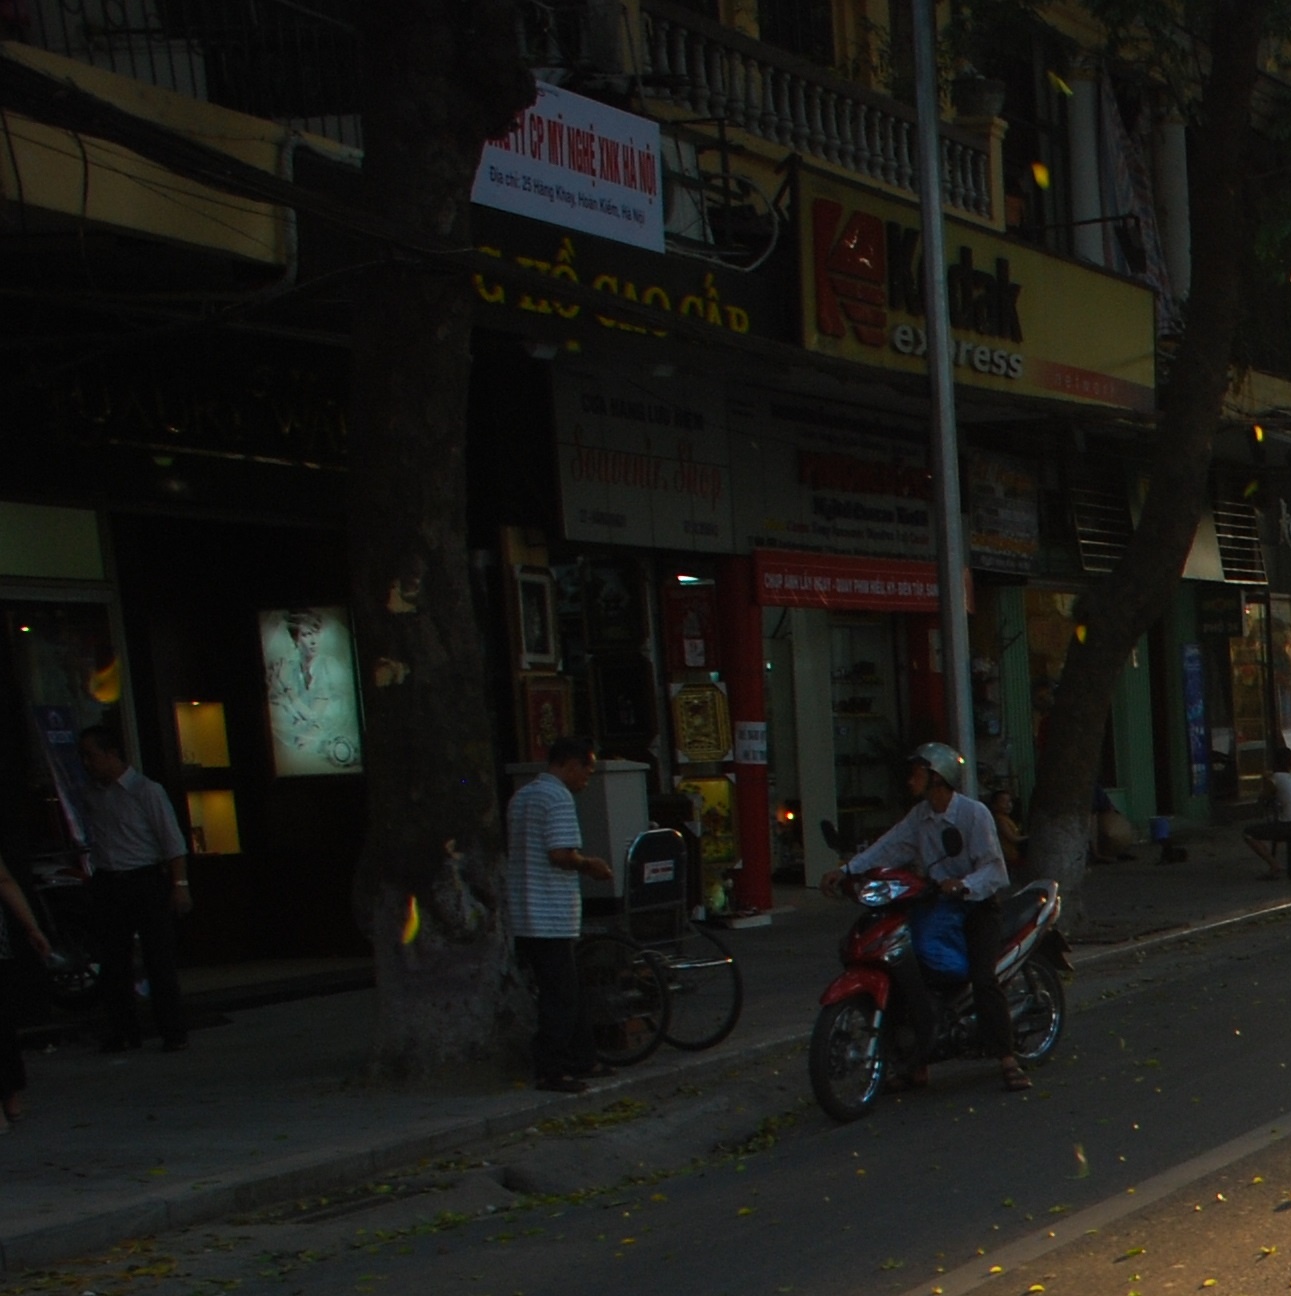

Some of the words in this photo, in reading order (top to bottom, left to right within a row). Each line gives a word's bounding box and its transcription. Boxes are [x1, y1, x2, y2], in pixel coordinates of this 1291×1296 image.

[529, 113, 544, 160] CP
[567, 124, 597, 187] NGHỆ
[598, 136, 621, 185] XNK
[622, 137, 637, 190] HÀ
[638, 144, 657, 204] NỘI
[489, 166, 504, 184] Địa
[522, 175, 533, 193] 25
[534, 180, 555, 203] Hàng
[577, 191, 598, 210] Hoàn
[621, 203, 632, 222] Hà
[633, 206, 645, 226] Nội
[893, 323, 1025, 377] exress
